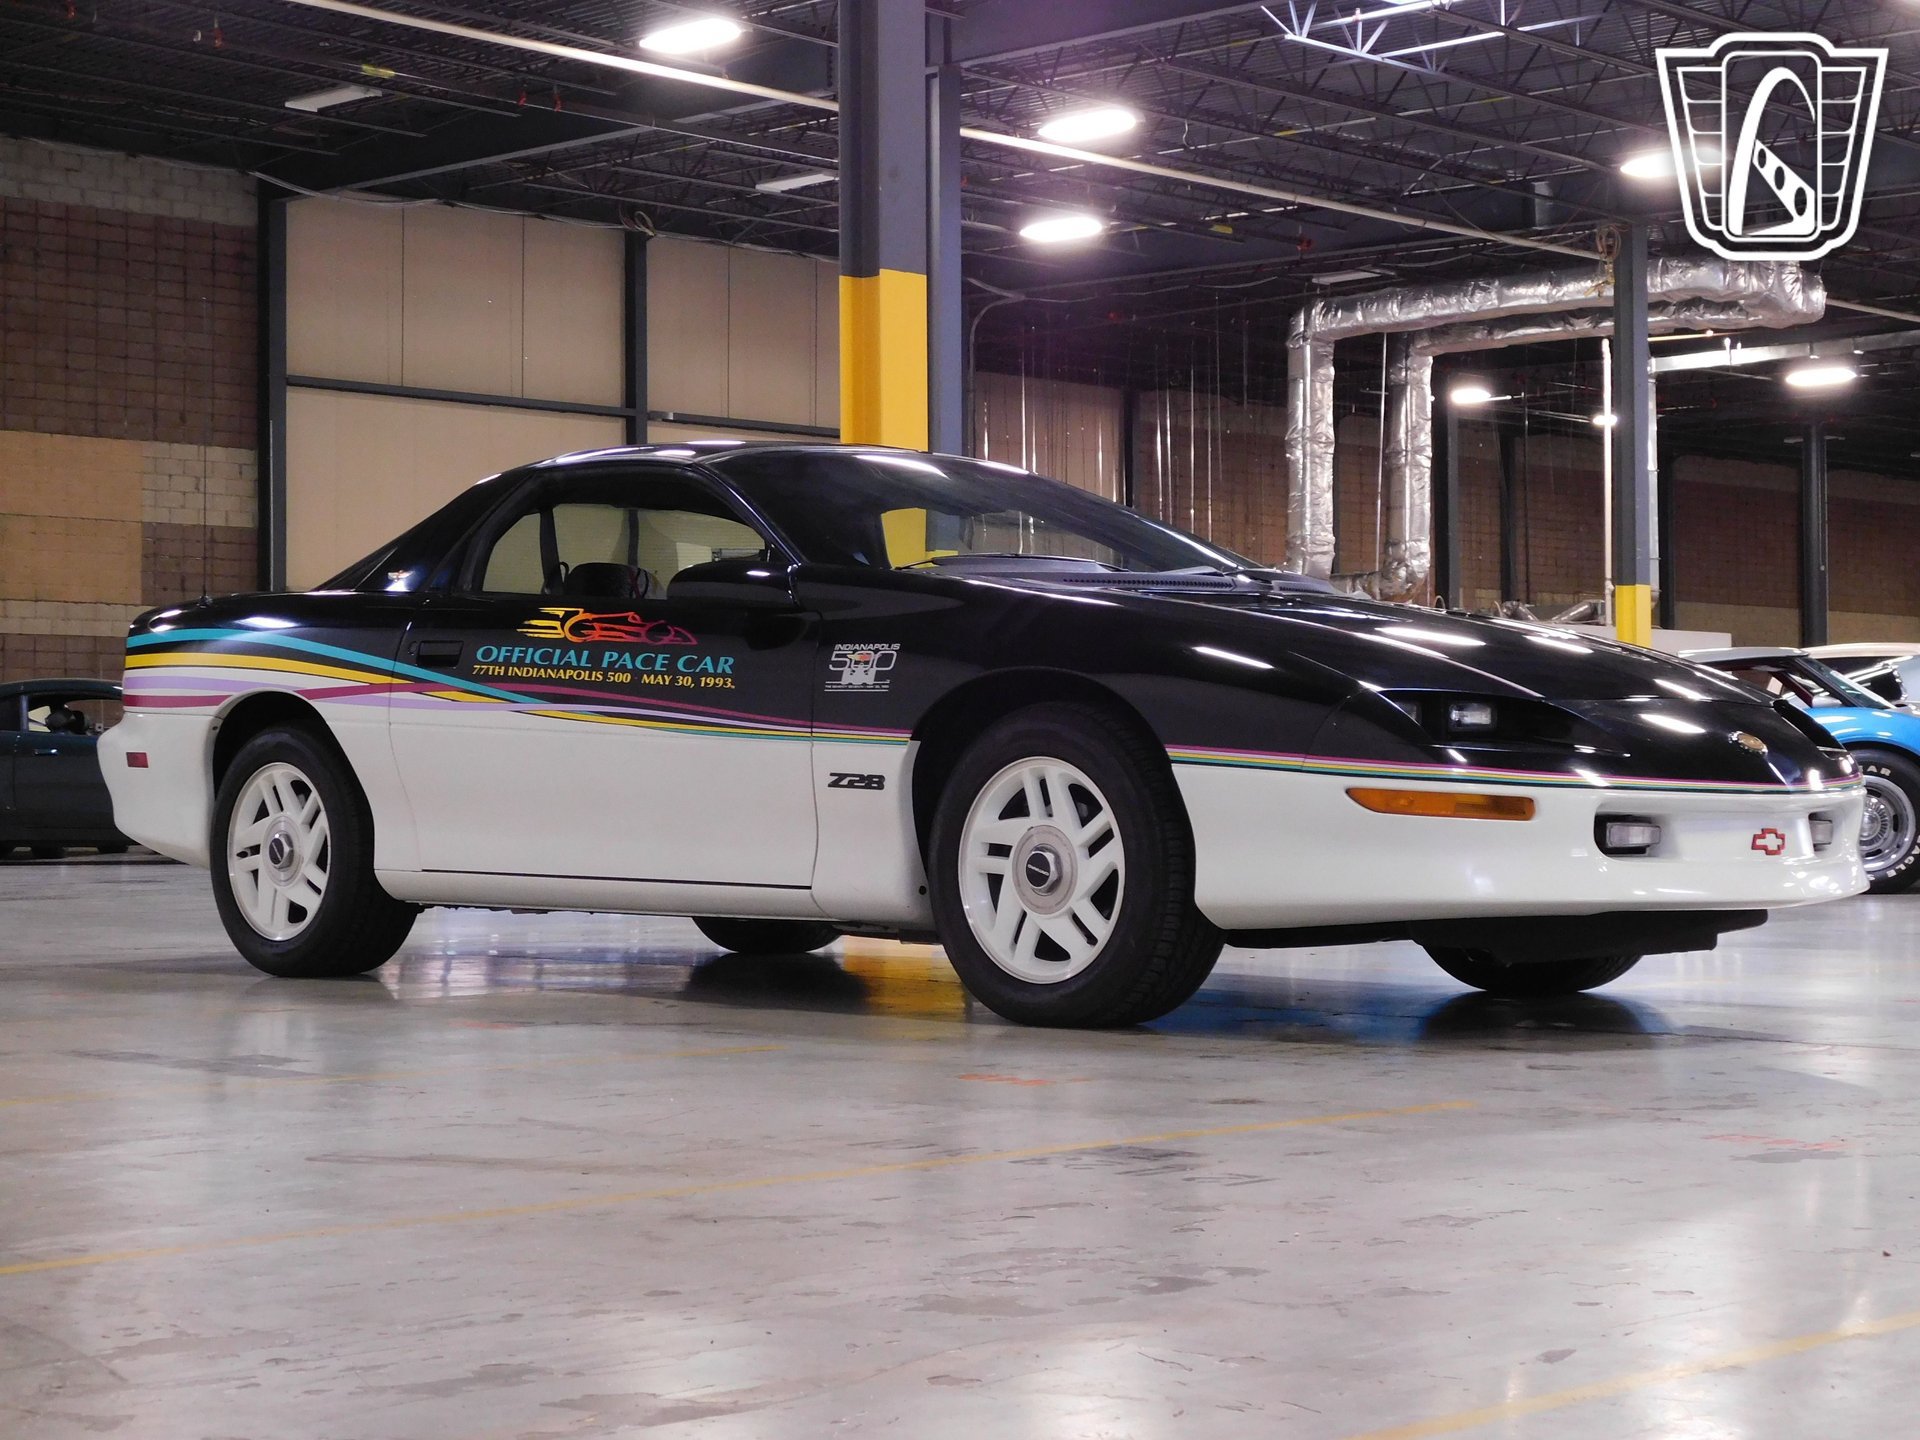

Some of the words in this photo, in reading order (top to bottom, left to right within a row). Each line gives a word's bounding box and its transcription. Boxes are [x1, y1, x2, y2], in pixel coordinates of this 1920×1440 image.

[834, 643, 901, 651] INDIANAPOLIS
[476, 645, 592, 667] OFFICIAL
[601, 651, 671, 671] PACE
[677, 654, 735, 674] CAR
[472, 665, 505, 676] 77TH
[507, 666, 603, 682] INDIANAPOLIS
[606, 672, 631, 683] 500
[641, 673, 673, 686] MAY
[674, 675, 695, 688] 30,
[828, 772, 885, 790] Z28
